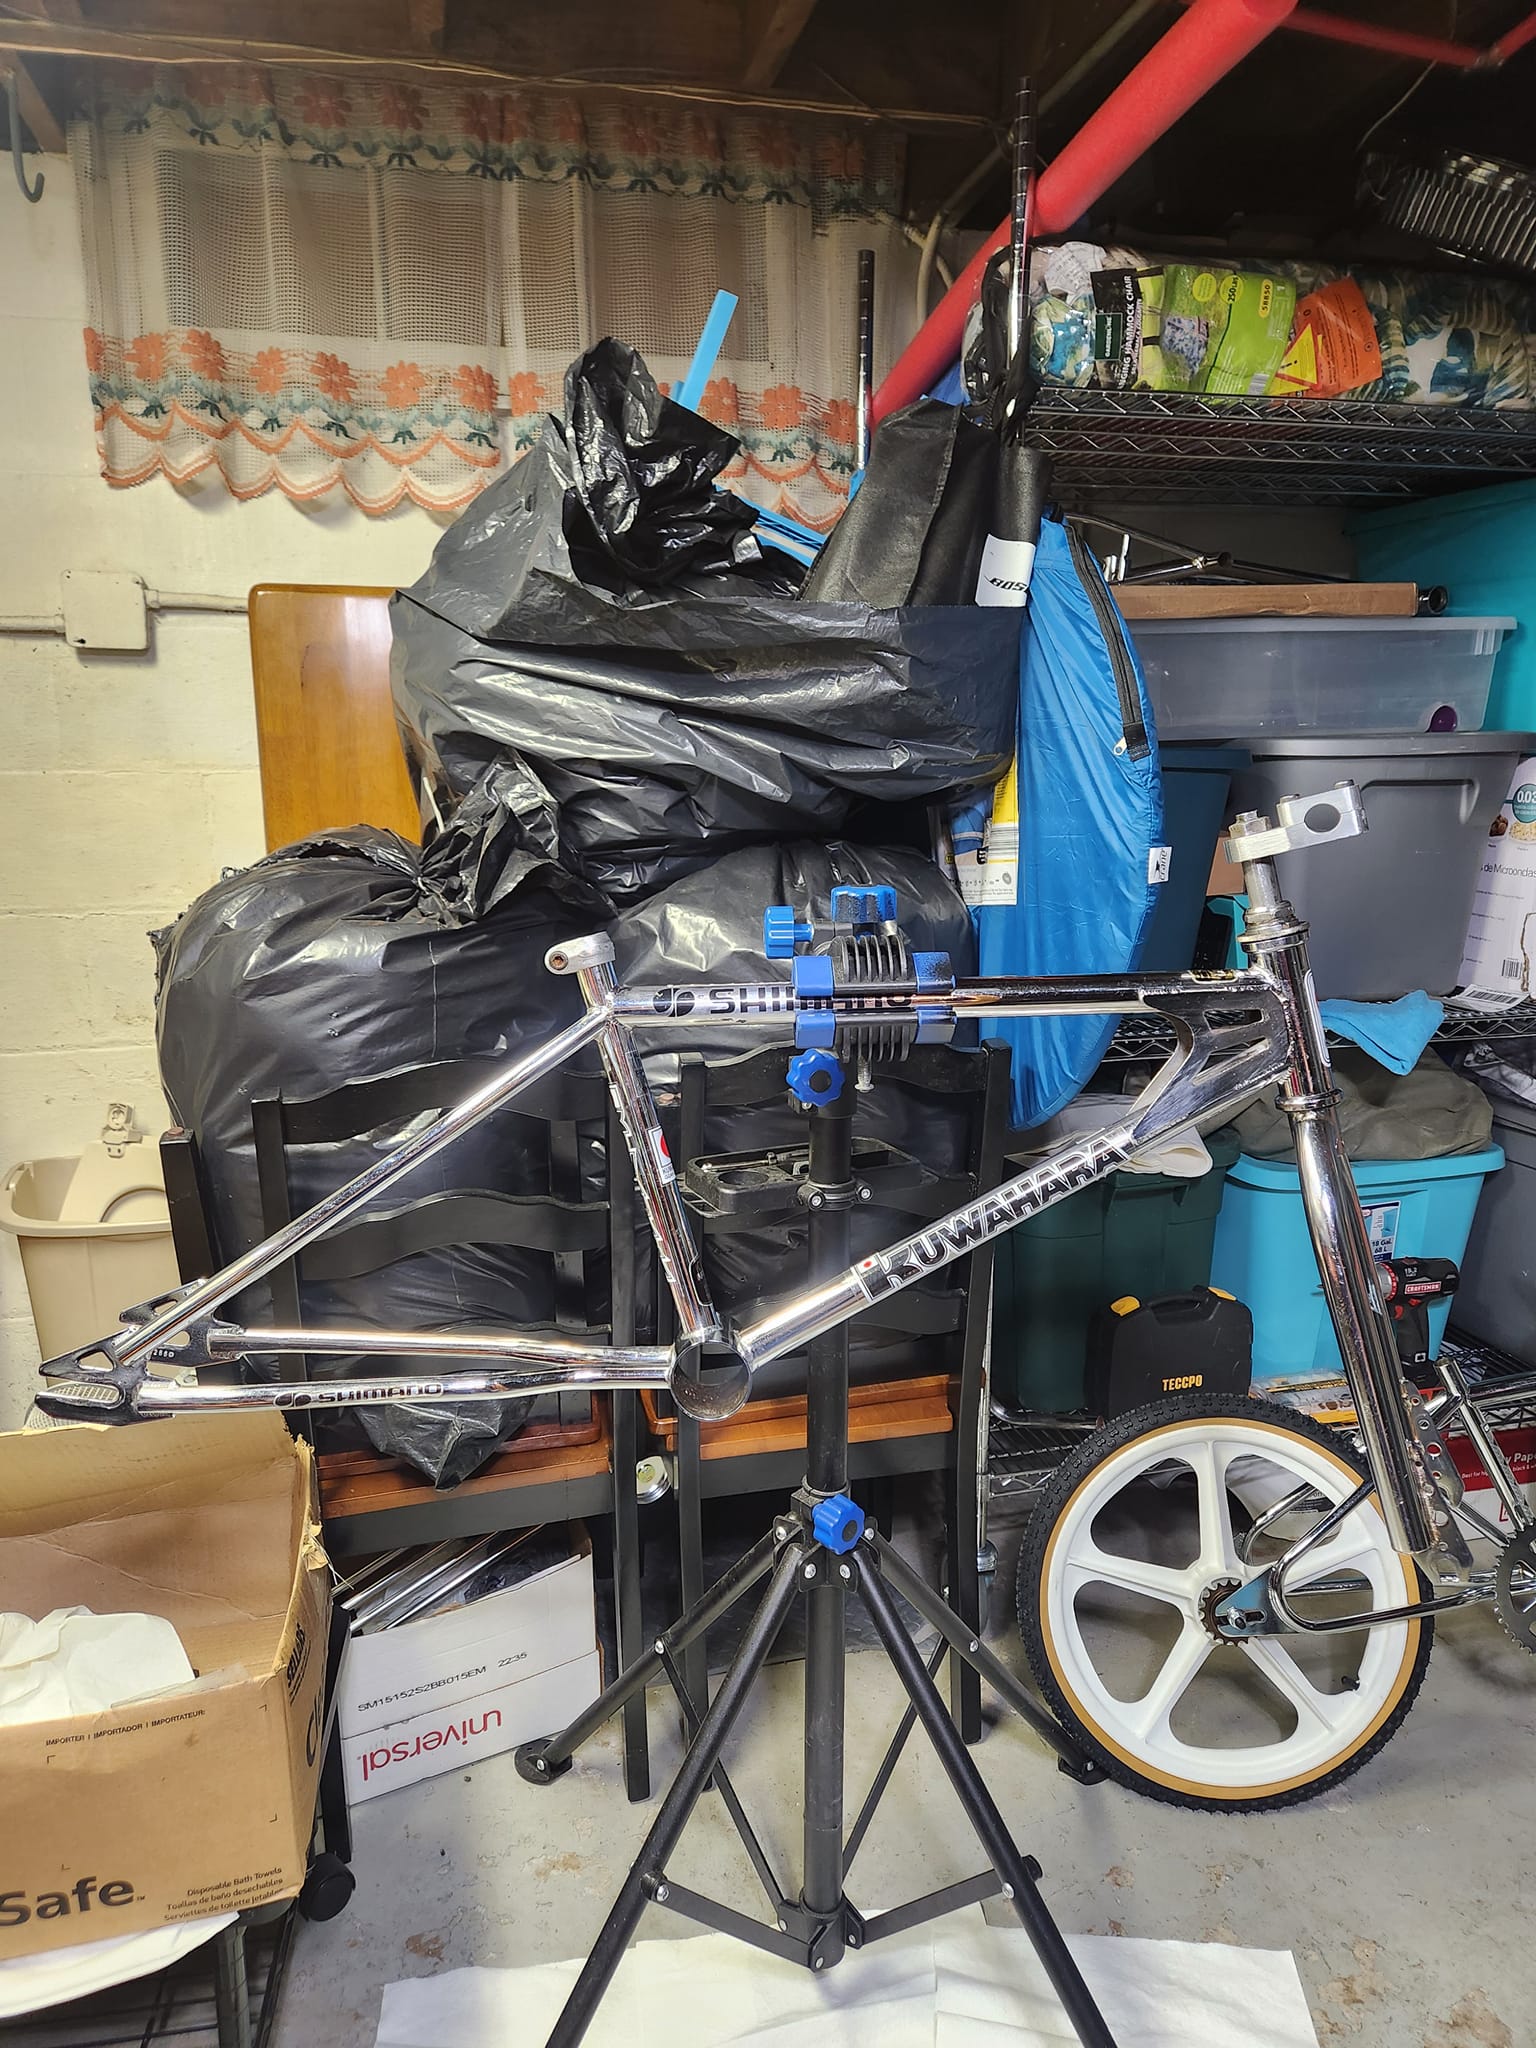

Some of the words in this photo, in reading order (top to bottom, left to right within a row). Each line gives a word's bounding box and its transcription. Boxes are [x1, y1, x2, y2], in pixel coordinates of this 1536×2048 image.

[1123, 275, 1135, 301] CHAIR
[1124, 303, 1135, 355] HAMMOCK
[988, 577, 1030, 594] BOS
[1484, 864, 1493, 873] de
[859, 1137, 1130, 1300] KUWAHARA
[1407, 1283, 1439, 1292] CRAFTSMAN
[318, 1383, 443, 1403] SHIMANO
[1162, 1374, 1203, 1391] TECCPO
[498, 1652, 528, 1668] 2235
[46, 1735, 85, 1746] IMPORTER
[93, 1723, 143, 1740] IMPORTADOR
[187, 1880, 232, 1897] Disposable
[233, 1875, 253, 1886] Bath
[254, 1867, 282, 1880] Towels
[167, 1899, 198, 1911] Toallas
[199, 1896, 209, 1904] de
[211, 1892, 232, 1901] baño
[233, 1878, 283, 1896] desechables
[164, 1906, 208, 1920] Serviettes
[209, 1904, 219, 1912] de
[221, 1898, 250, 1910] toilette
